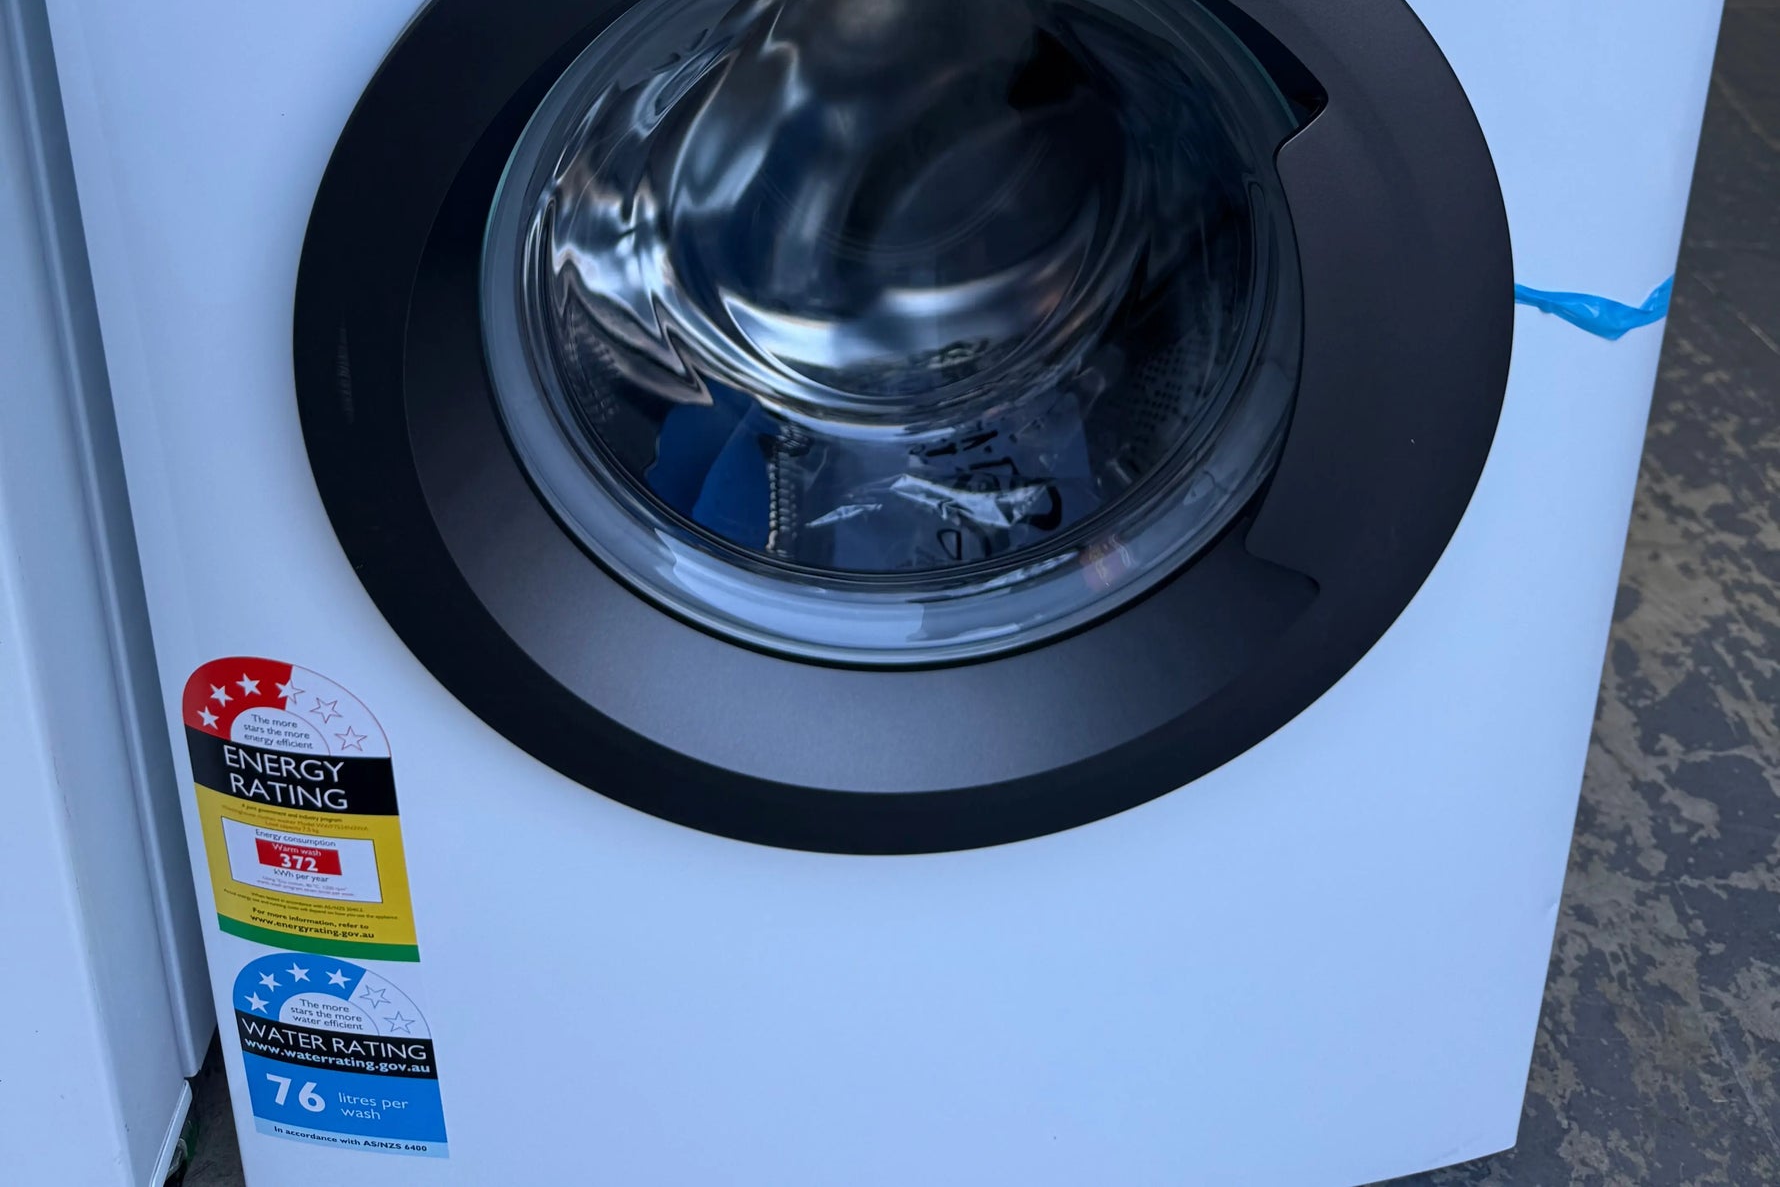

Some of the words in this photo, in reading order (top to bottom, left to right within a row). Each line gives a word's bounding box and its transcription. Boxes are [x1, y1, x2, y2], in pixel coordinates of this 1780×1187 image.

[251, 714, 270, 727] The
[272, 717, 297, 729] more
[244, 723, 266, 735] stars
[268, 725, 283, 738] the
[284, 728, 310, 739] more
[244, 732, 275, 747] energy
[276, 735, 314, 750] efficient
[222, 744, 345, 783] ENERGY
[229, 773, 348, 810] RATING
[255, 829, 282, 842] Energy
[284, 833, 336, 847] consumption
[272, 842, 297, 854] Warm
[300, 845, 322, 857] wash
[280, 853, 318, 872] 372
[274, 868, 294, 879] kWh
[296, 872, 310, 882] per
[311, 874, 329, 884] year
[250, 914, 375, 939] www.energyrating.gov.au
[267, 911, 287, 920] more
[289, 915, 337, 928] information,
[338, 921, 358, 929] refer
[290, 1006, 314, 1017] stars
[316, 1008, 333, 1020] the
[334, 1011, 363, 1023] more
[299, 998, 320, 1011] The
[322, 1002, 350, 1013] more
[292, 1015, 322, 1027] water
[323, 1018, 364, 1031] efficient
[241, 1018, 328, 1052] WATER
[332, 1037, 427, 1061] RATING
[244, 1038, 431, 1074] www.waterrating.gov.au
[266, 1073, 326, 1113] 76
[338, 1092, 377, 1107] litres
[382, 1097, 409, 1110] per
[341, 1106, 382, 1120] wash
[273, 1125, 284, 1135] In
[285, 1127, 338, 1144] accordance
[340, 1137, 361, 1147] with
[363, 1139, 402, 1151] AS/NZS
[404, 1143, 428, 1152] 6400
